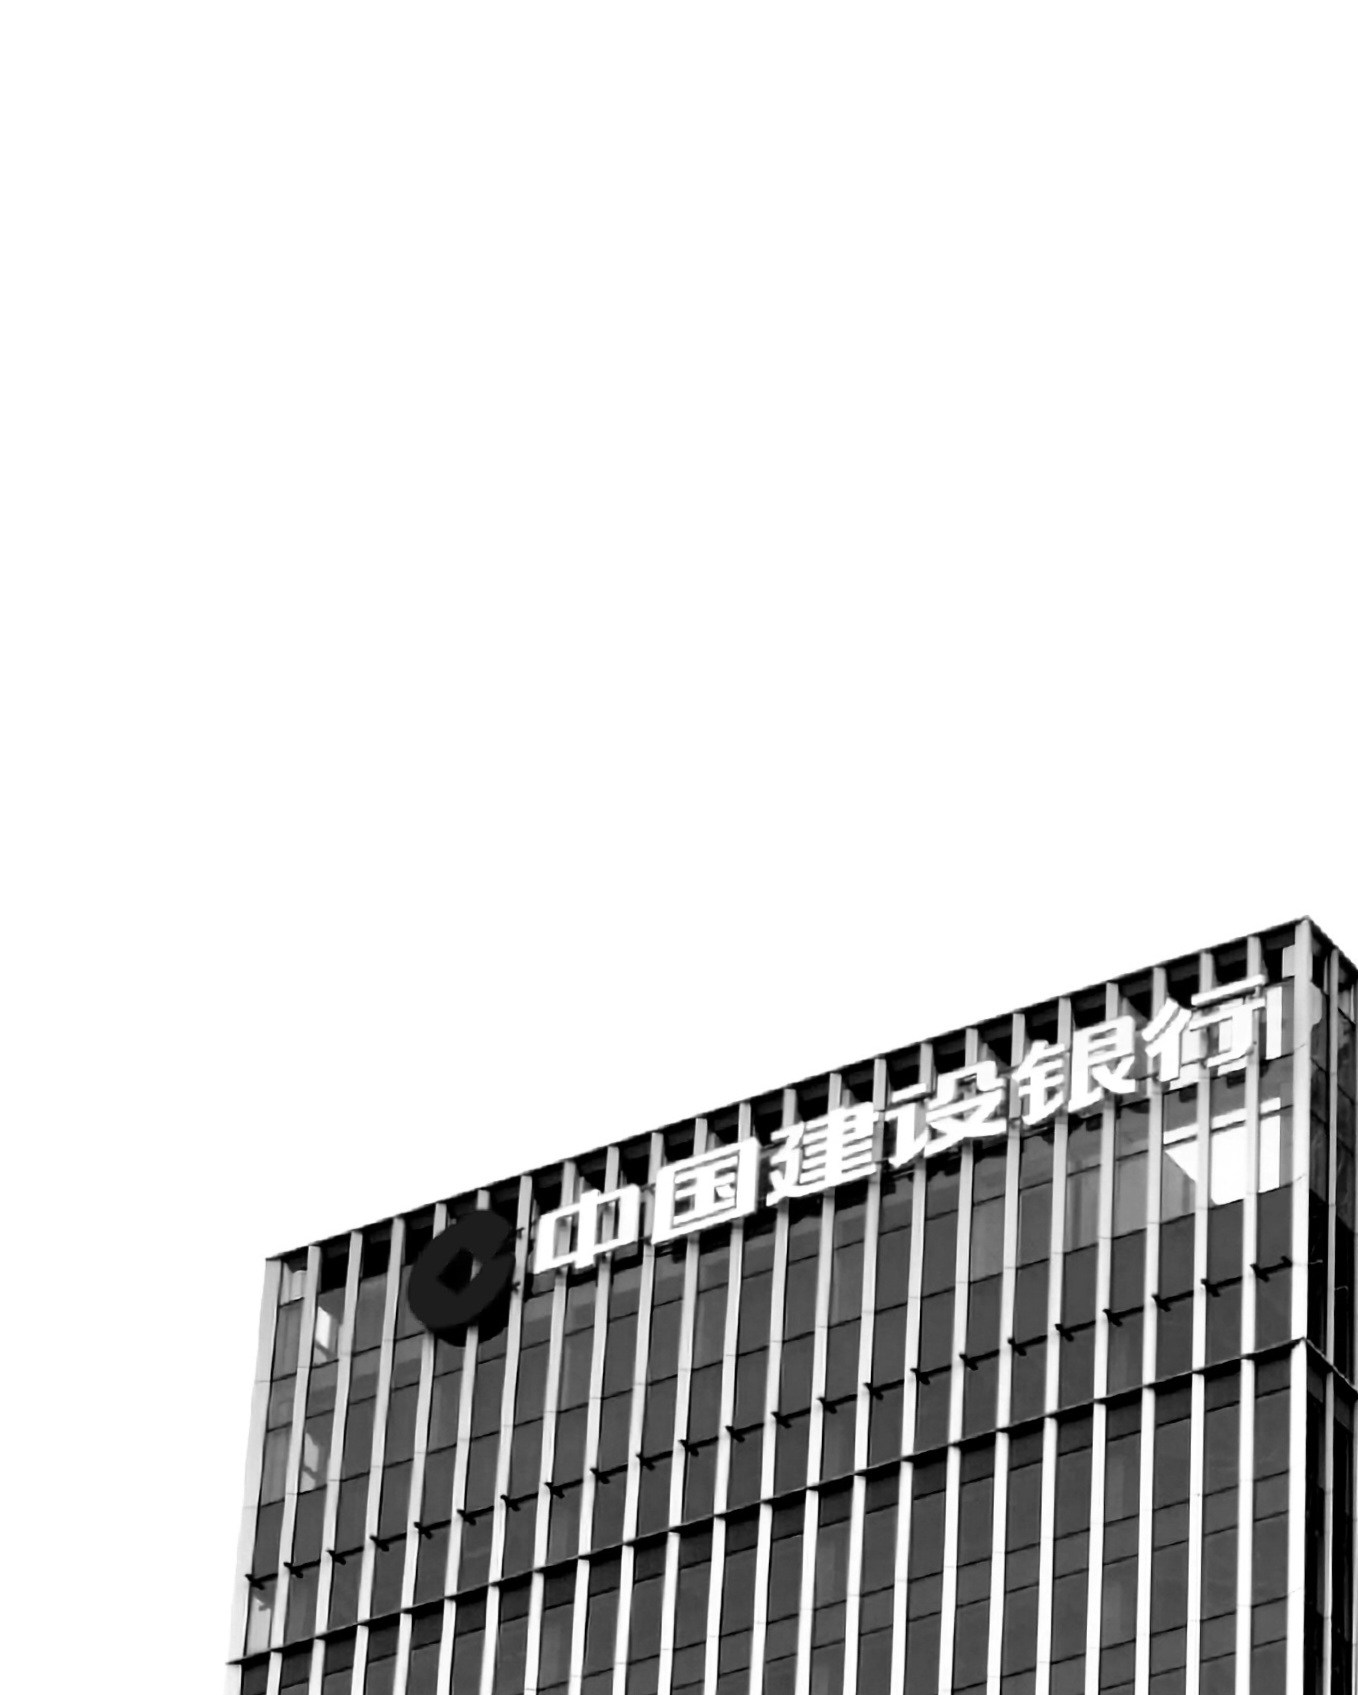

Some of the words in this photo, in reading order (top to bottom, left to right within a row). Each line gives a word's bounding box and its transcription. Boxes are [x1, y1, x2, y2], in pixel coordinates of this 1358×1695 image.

[532, 974, 1266, 1275] 中国建设银行
